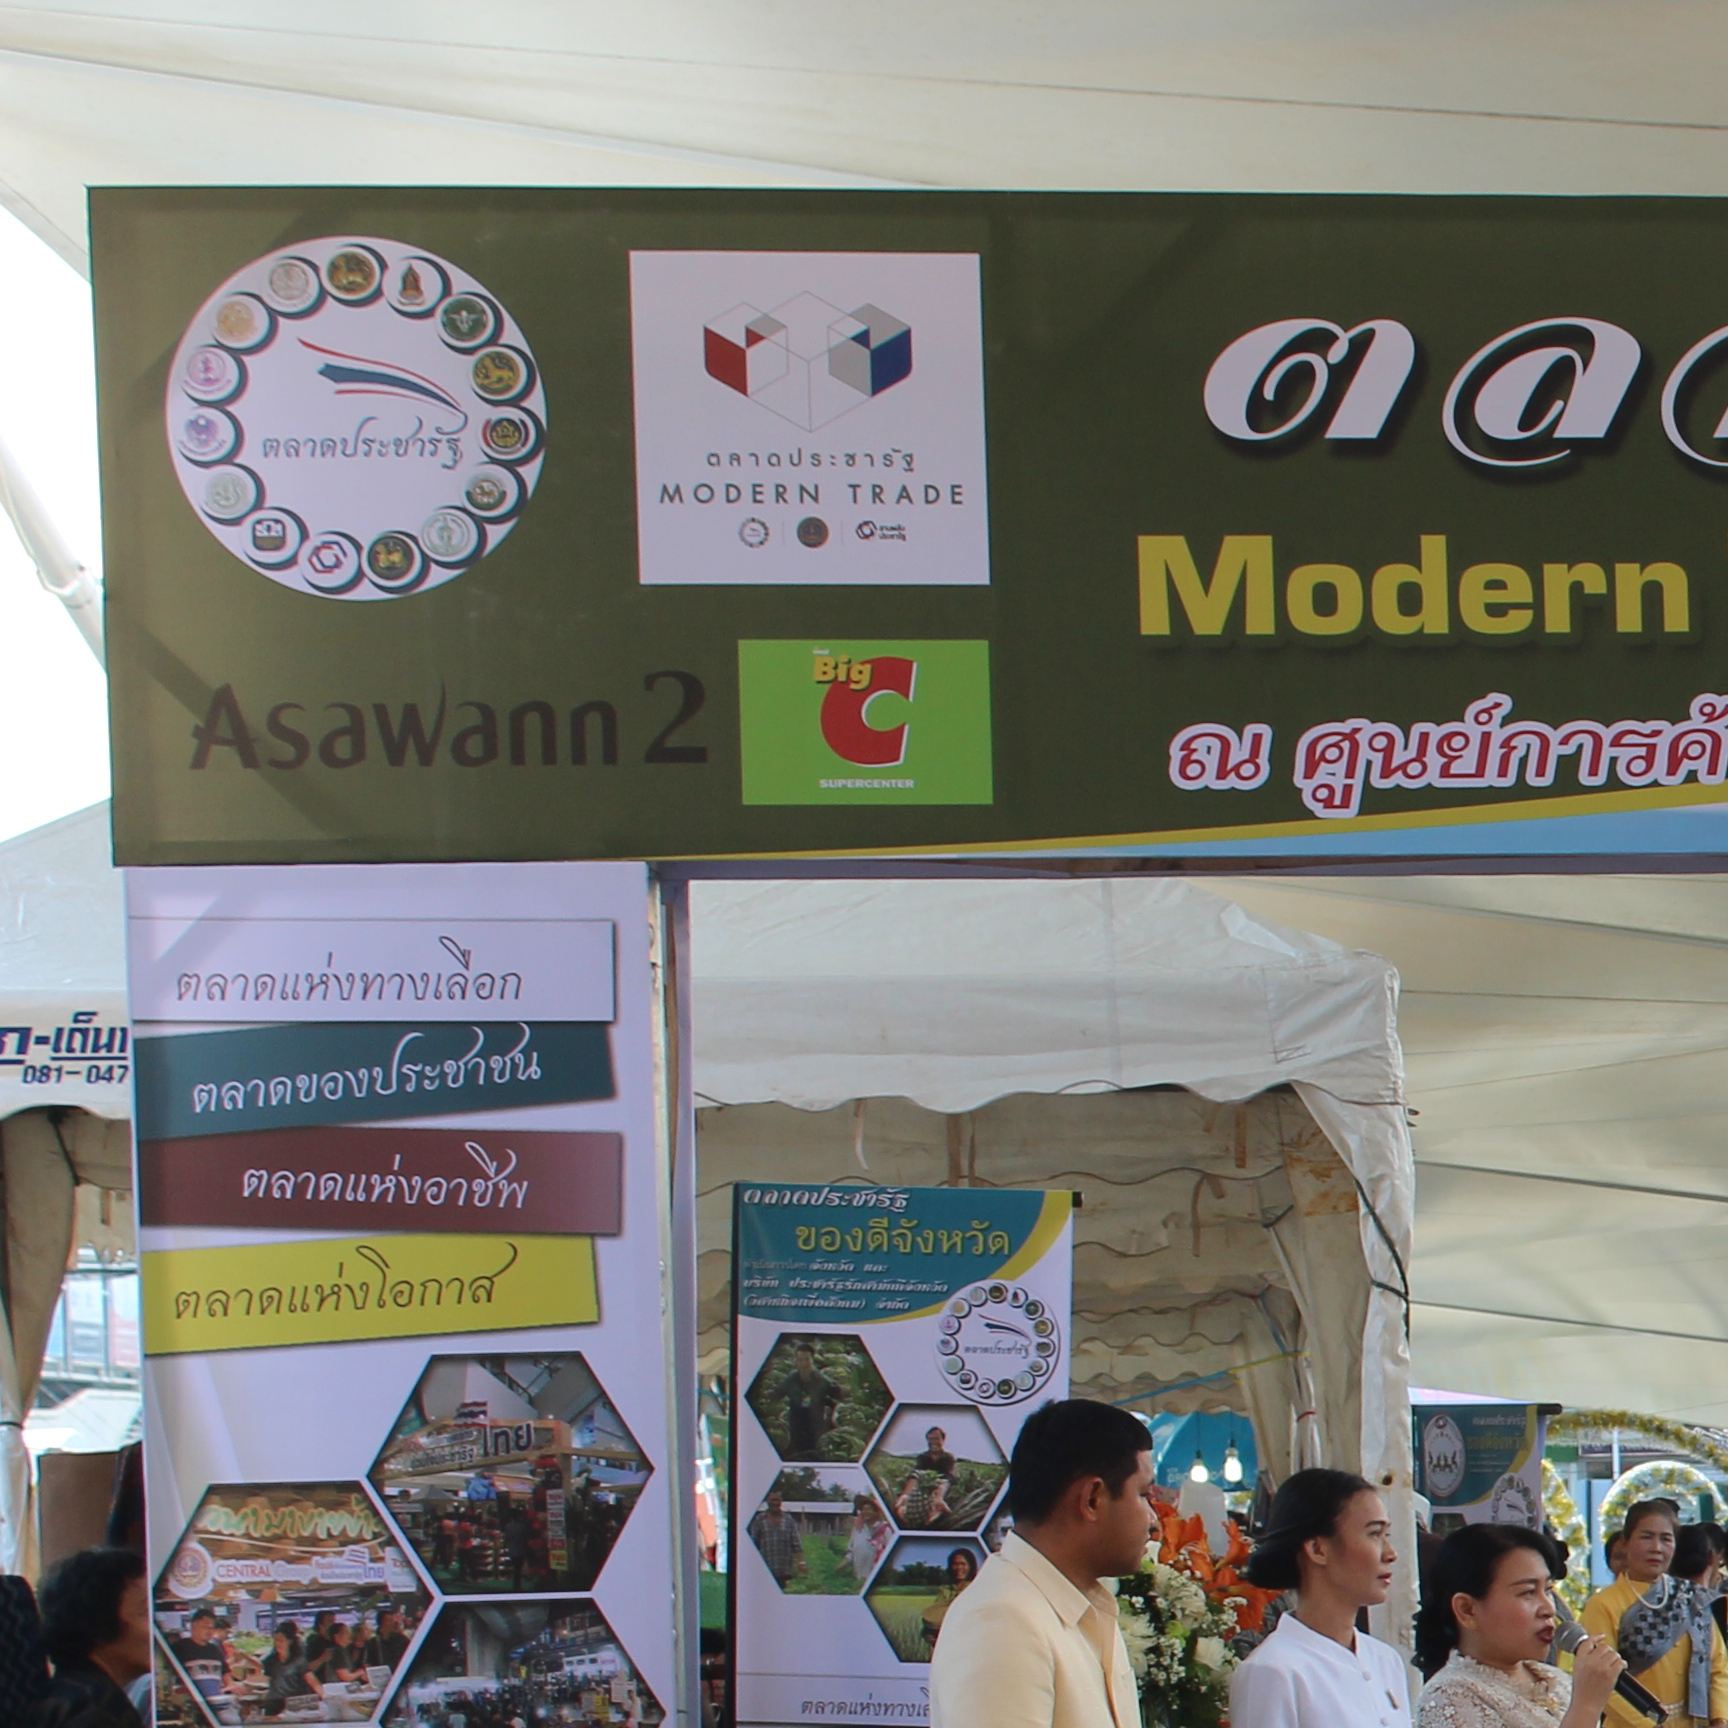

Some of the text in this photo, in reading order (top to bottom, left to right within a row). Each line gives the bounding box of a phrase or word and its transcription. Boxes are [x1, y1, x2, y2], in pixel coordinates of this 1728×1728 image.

[261, 416, 463, 469] ตลาดประชารัฐ
[707, 448, 915, 472] ตลาดประชารัฐ
[659, 483, 964, 506] MODERN TRADE
[1136, 532, 1690, 637] Modern
[812, 655, 872, 690] Big
[189, 670, 710, 772] Asawann 2
[820, 656, 917, 767] C
[1175, 723, 1263, 783] ณ
[819, 778, 915, 789] SUPERCENTER
[176, 936, 523, 1003] ตลาดแห่งทางเลือก
[193, 1022, 542, 1114] ตลาดของประชาชน
[242, 1141, 529, 1209] ตลาดแห่งอาชีพ
[743, 1186, 911, 1214] ตลาดประชารัฐ
[795, 1217, 1011, 1256] ของดีจังหวัด
[174, 1243, 518, 1322] ตลาดแห่งโอกาส
[482, 1421, 534, 1458] ไทย
[216, 1565, 271, 1578] CENTRAL
